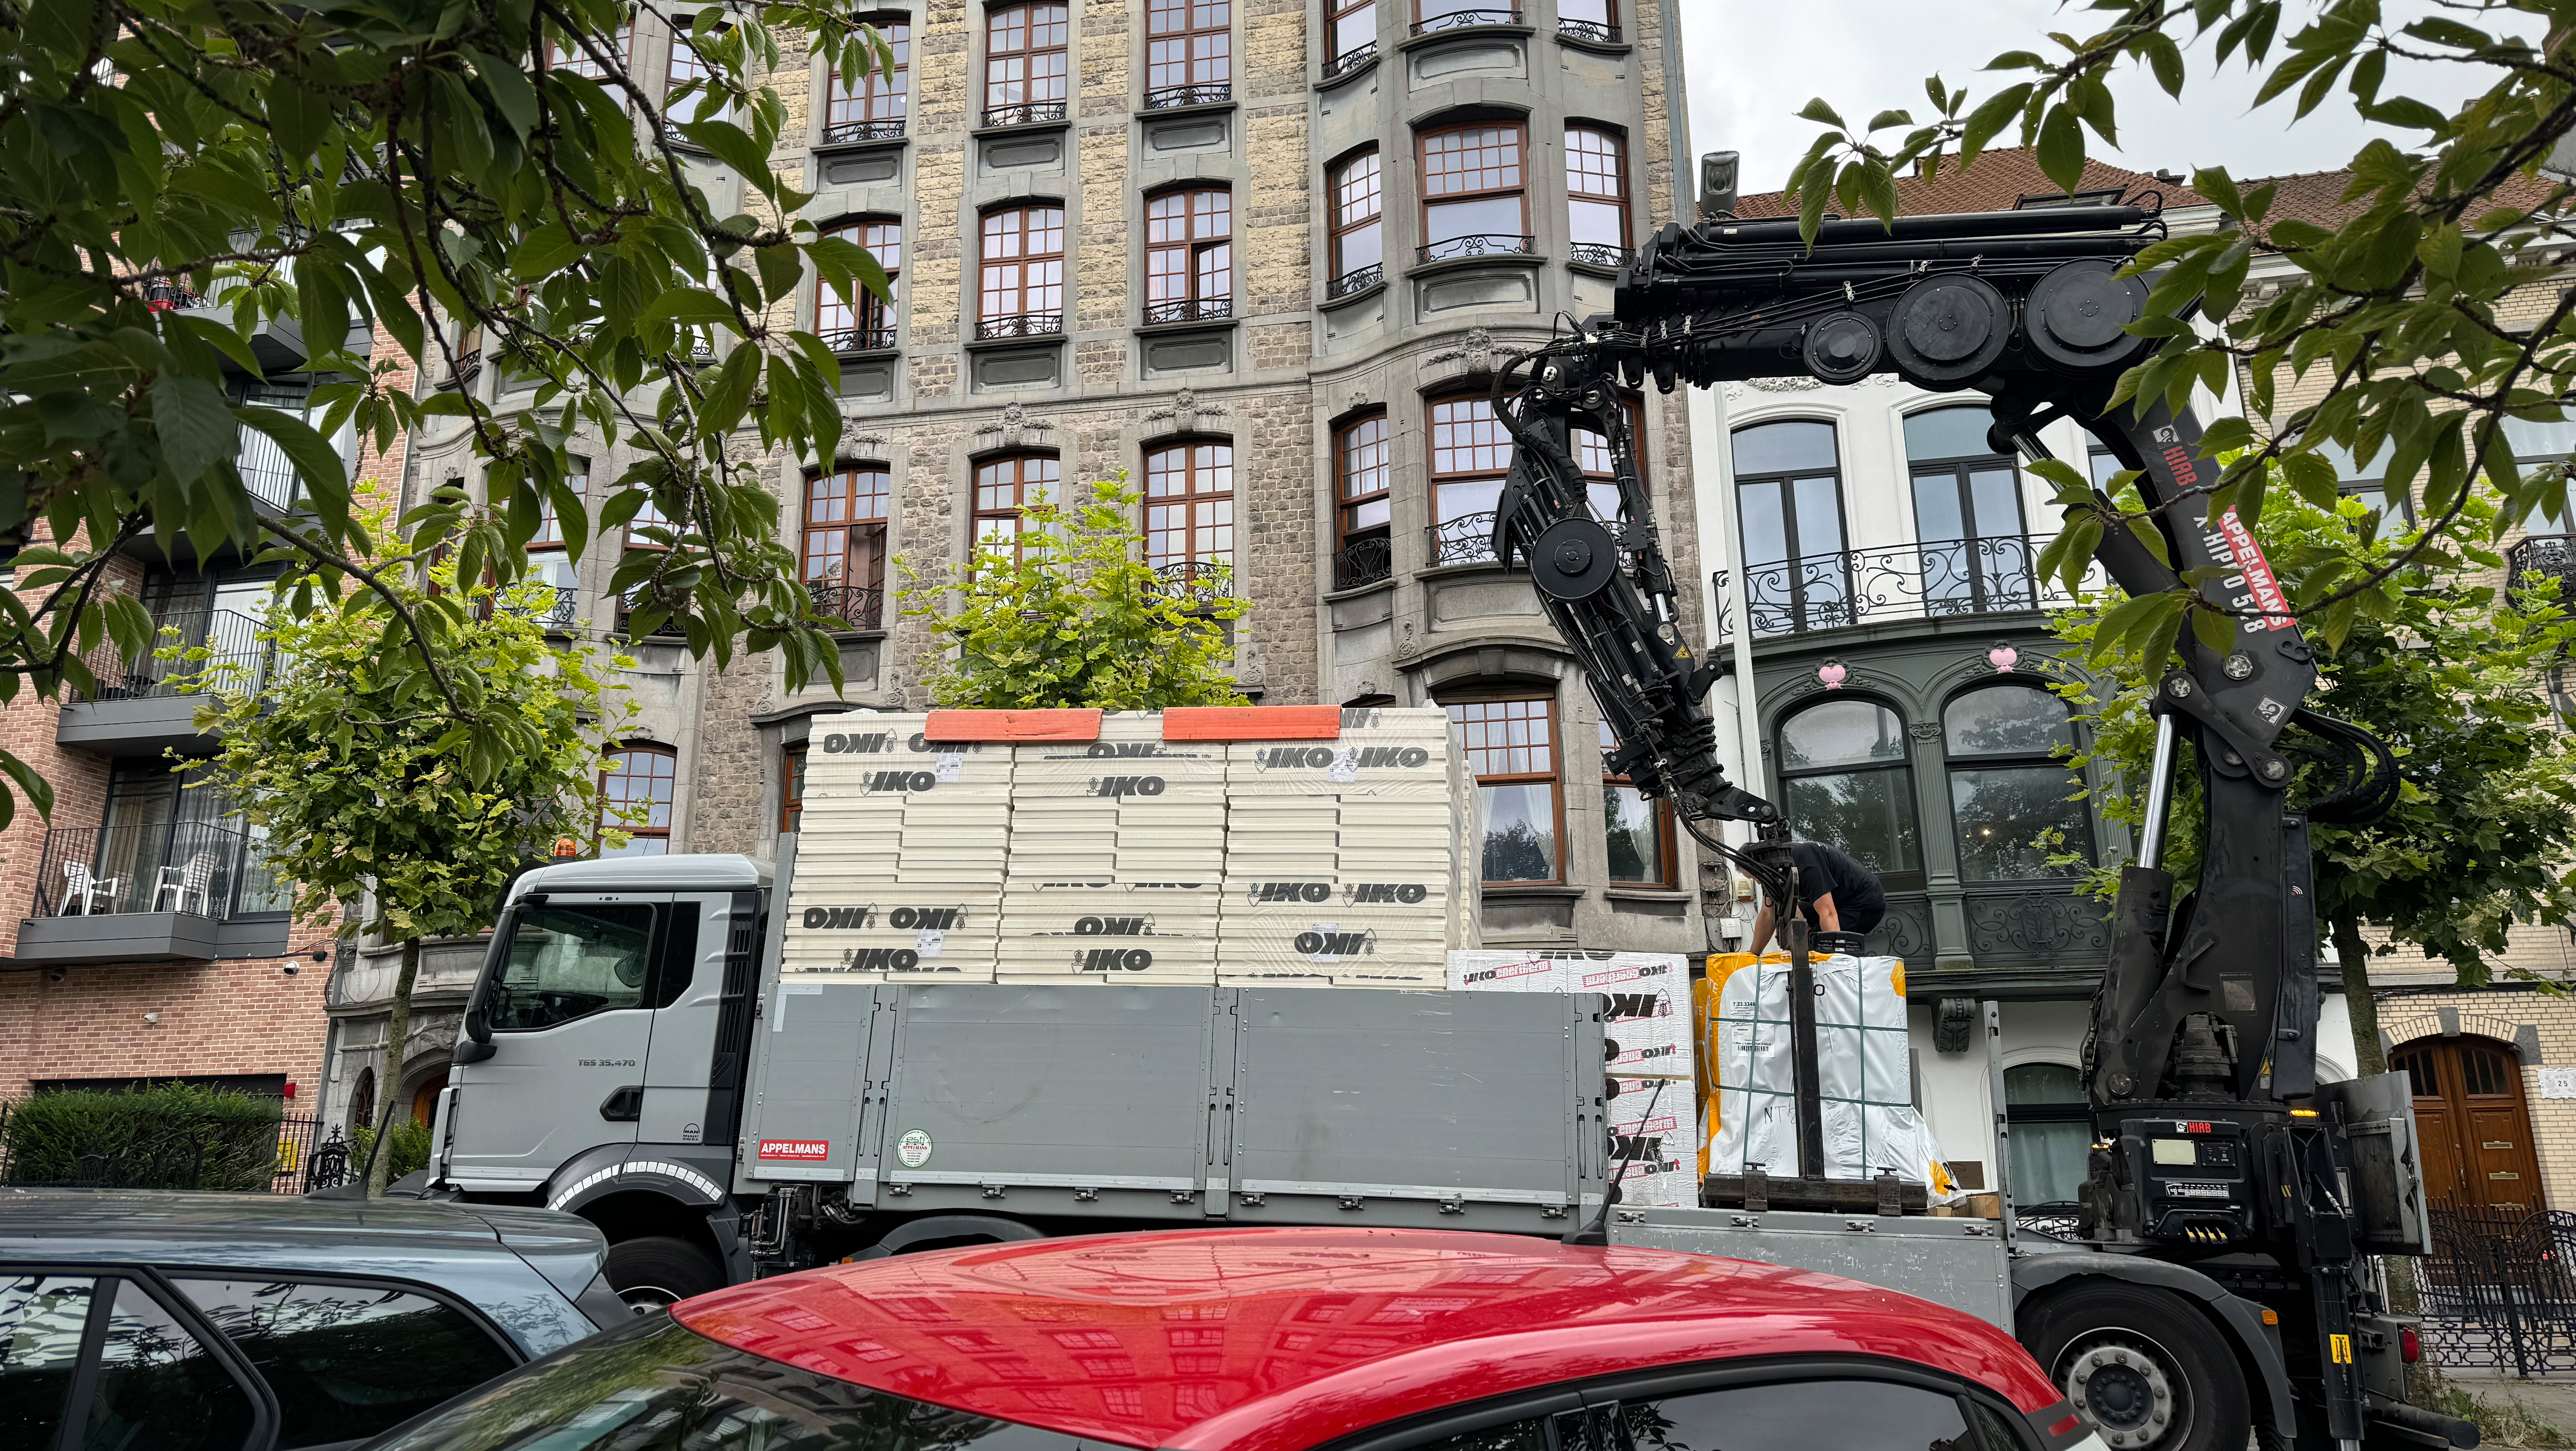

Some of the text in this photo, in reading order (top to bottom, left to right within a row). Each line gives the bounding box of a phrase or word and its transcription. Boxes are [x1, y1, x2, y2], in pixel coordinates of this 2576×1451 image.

[2162, 446, 2197, 486] HIAB
[2223, 512, 2287, 626] APPELMANS
[823, 733, 886, 754] IKO
[1267, 747, 1429, 768] IKO IKO
[870, 771, 936, 792] IKO
[1098, 776, 1165, 796] IKO
[1260, 883, 1427, 904] IKO IKO
[803, 907, 957, 930] IKO IKO
[1074, 917, 1144, 935] IKO
[1294, 932, 1365, 955] IKO
[851, 948, 919, 969] IKO
[1083, 949, 1152, 971] IKO
[1603, 993, 1657, 1018] IK
[2188, 1122, 2212, 1133] HIAB
[761, 1143, 826, 1154] APPELMANS
